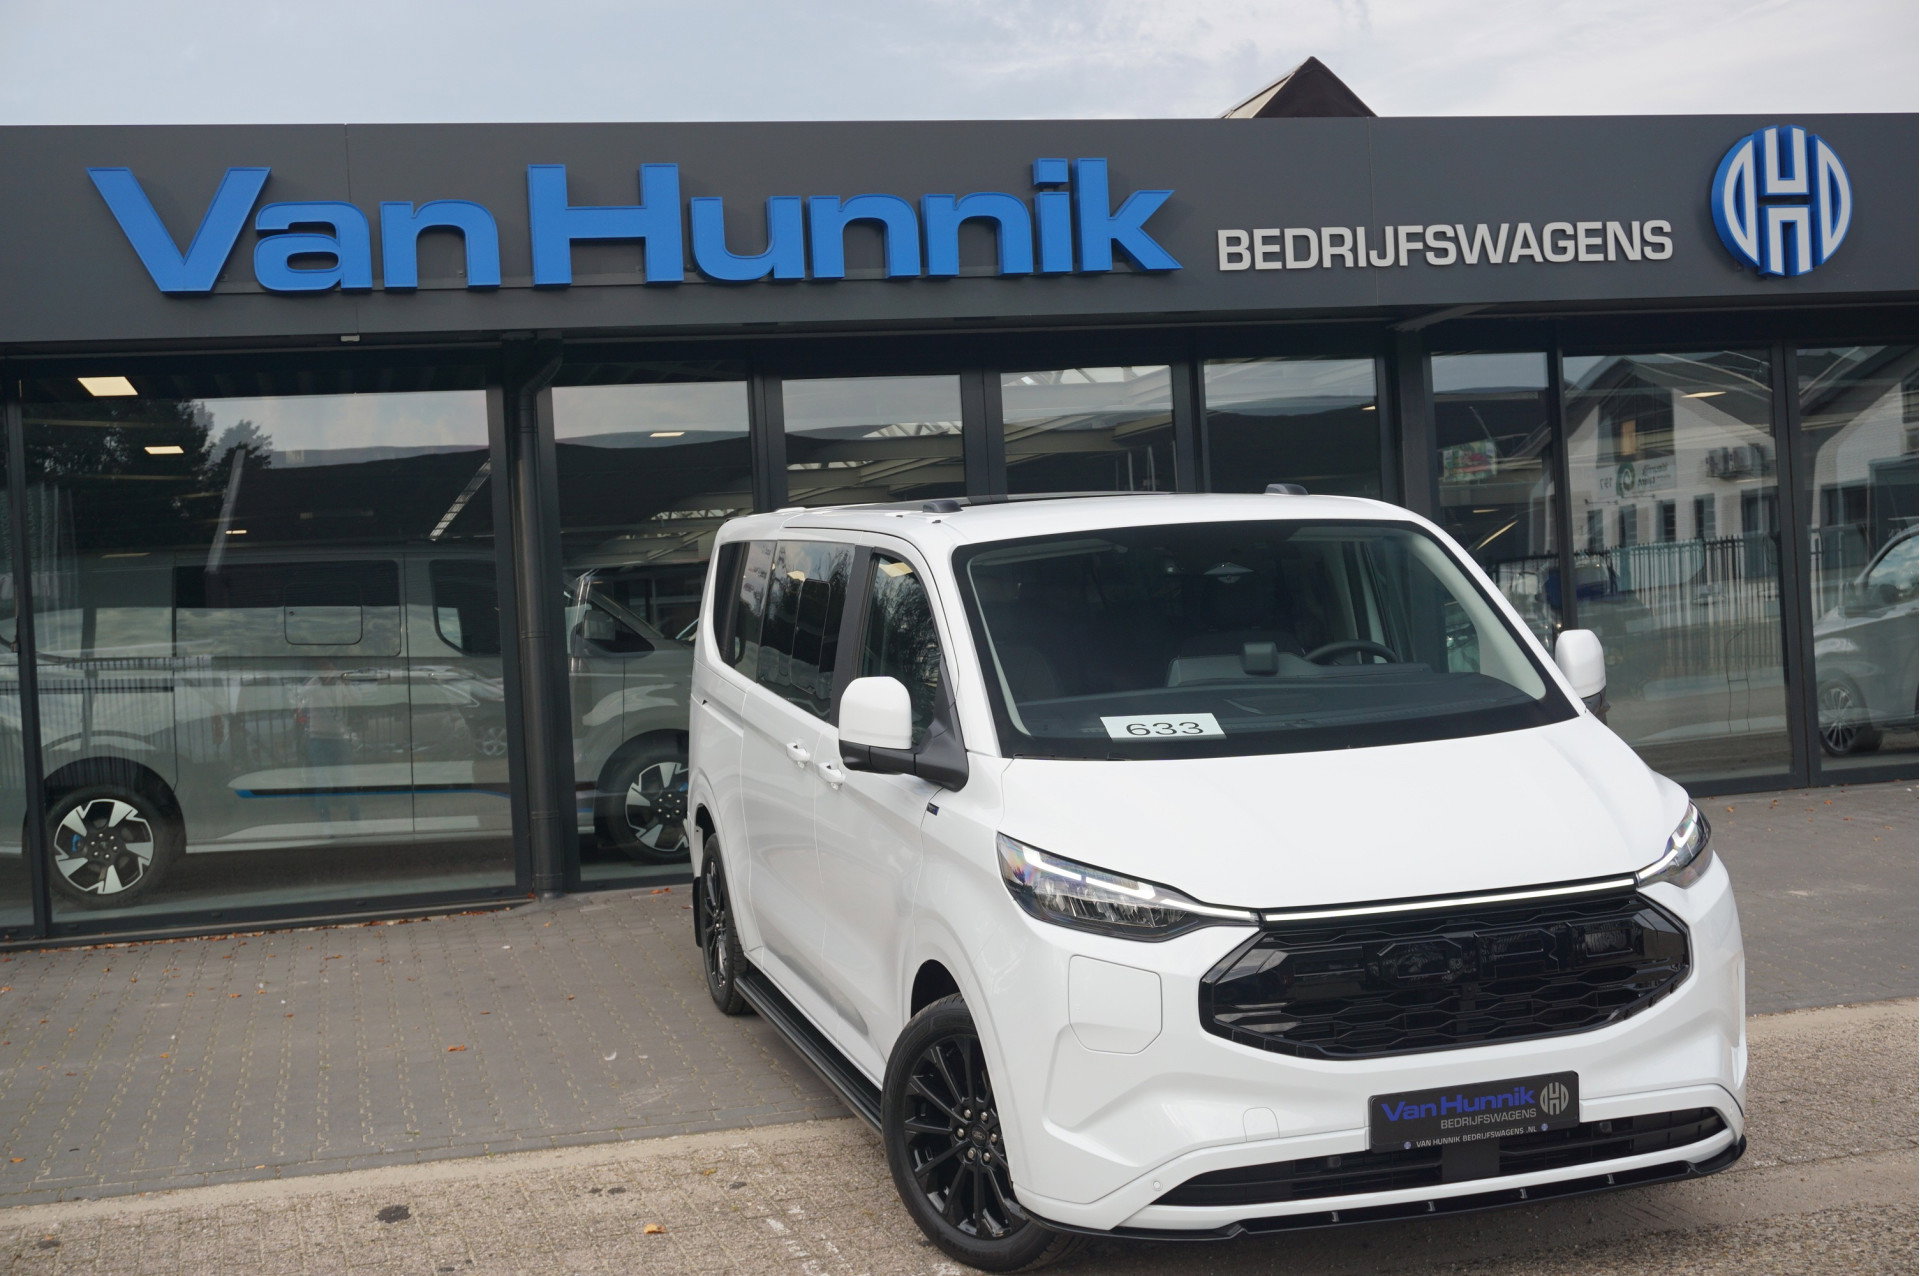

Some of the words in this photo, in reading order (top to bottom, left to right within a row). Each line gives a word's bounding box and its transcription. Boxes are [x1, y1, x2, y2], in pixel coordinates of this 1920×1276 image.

[86, 166, 501, 296] Van
[527, 157, 1183, 288] Hunnik
[1217, 219, 1674, 272] BEDRIJFSWAGENS
[1126, 721, 1204, 736] 633
[1381, 1101, 1437, 1122] Van
[1440, 1086, 1535, 1116] Hunnik
[1440, 1108, 1537, 1129] BEDRIJFSWAGENS
[1416, 1139, 1432, 1148] VAN
[1432, 1136, 1461, 1146] HUNNIK
[1462, 1127, 1524, 1142] BEDRIJFSWAGENS
